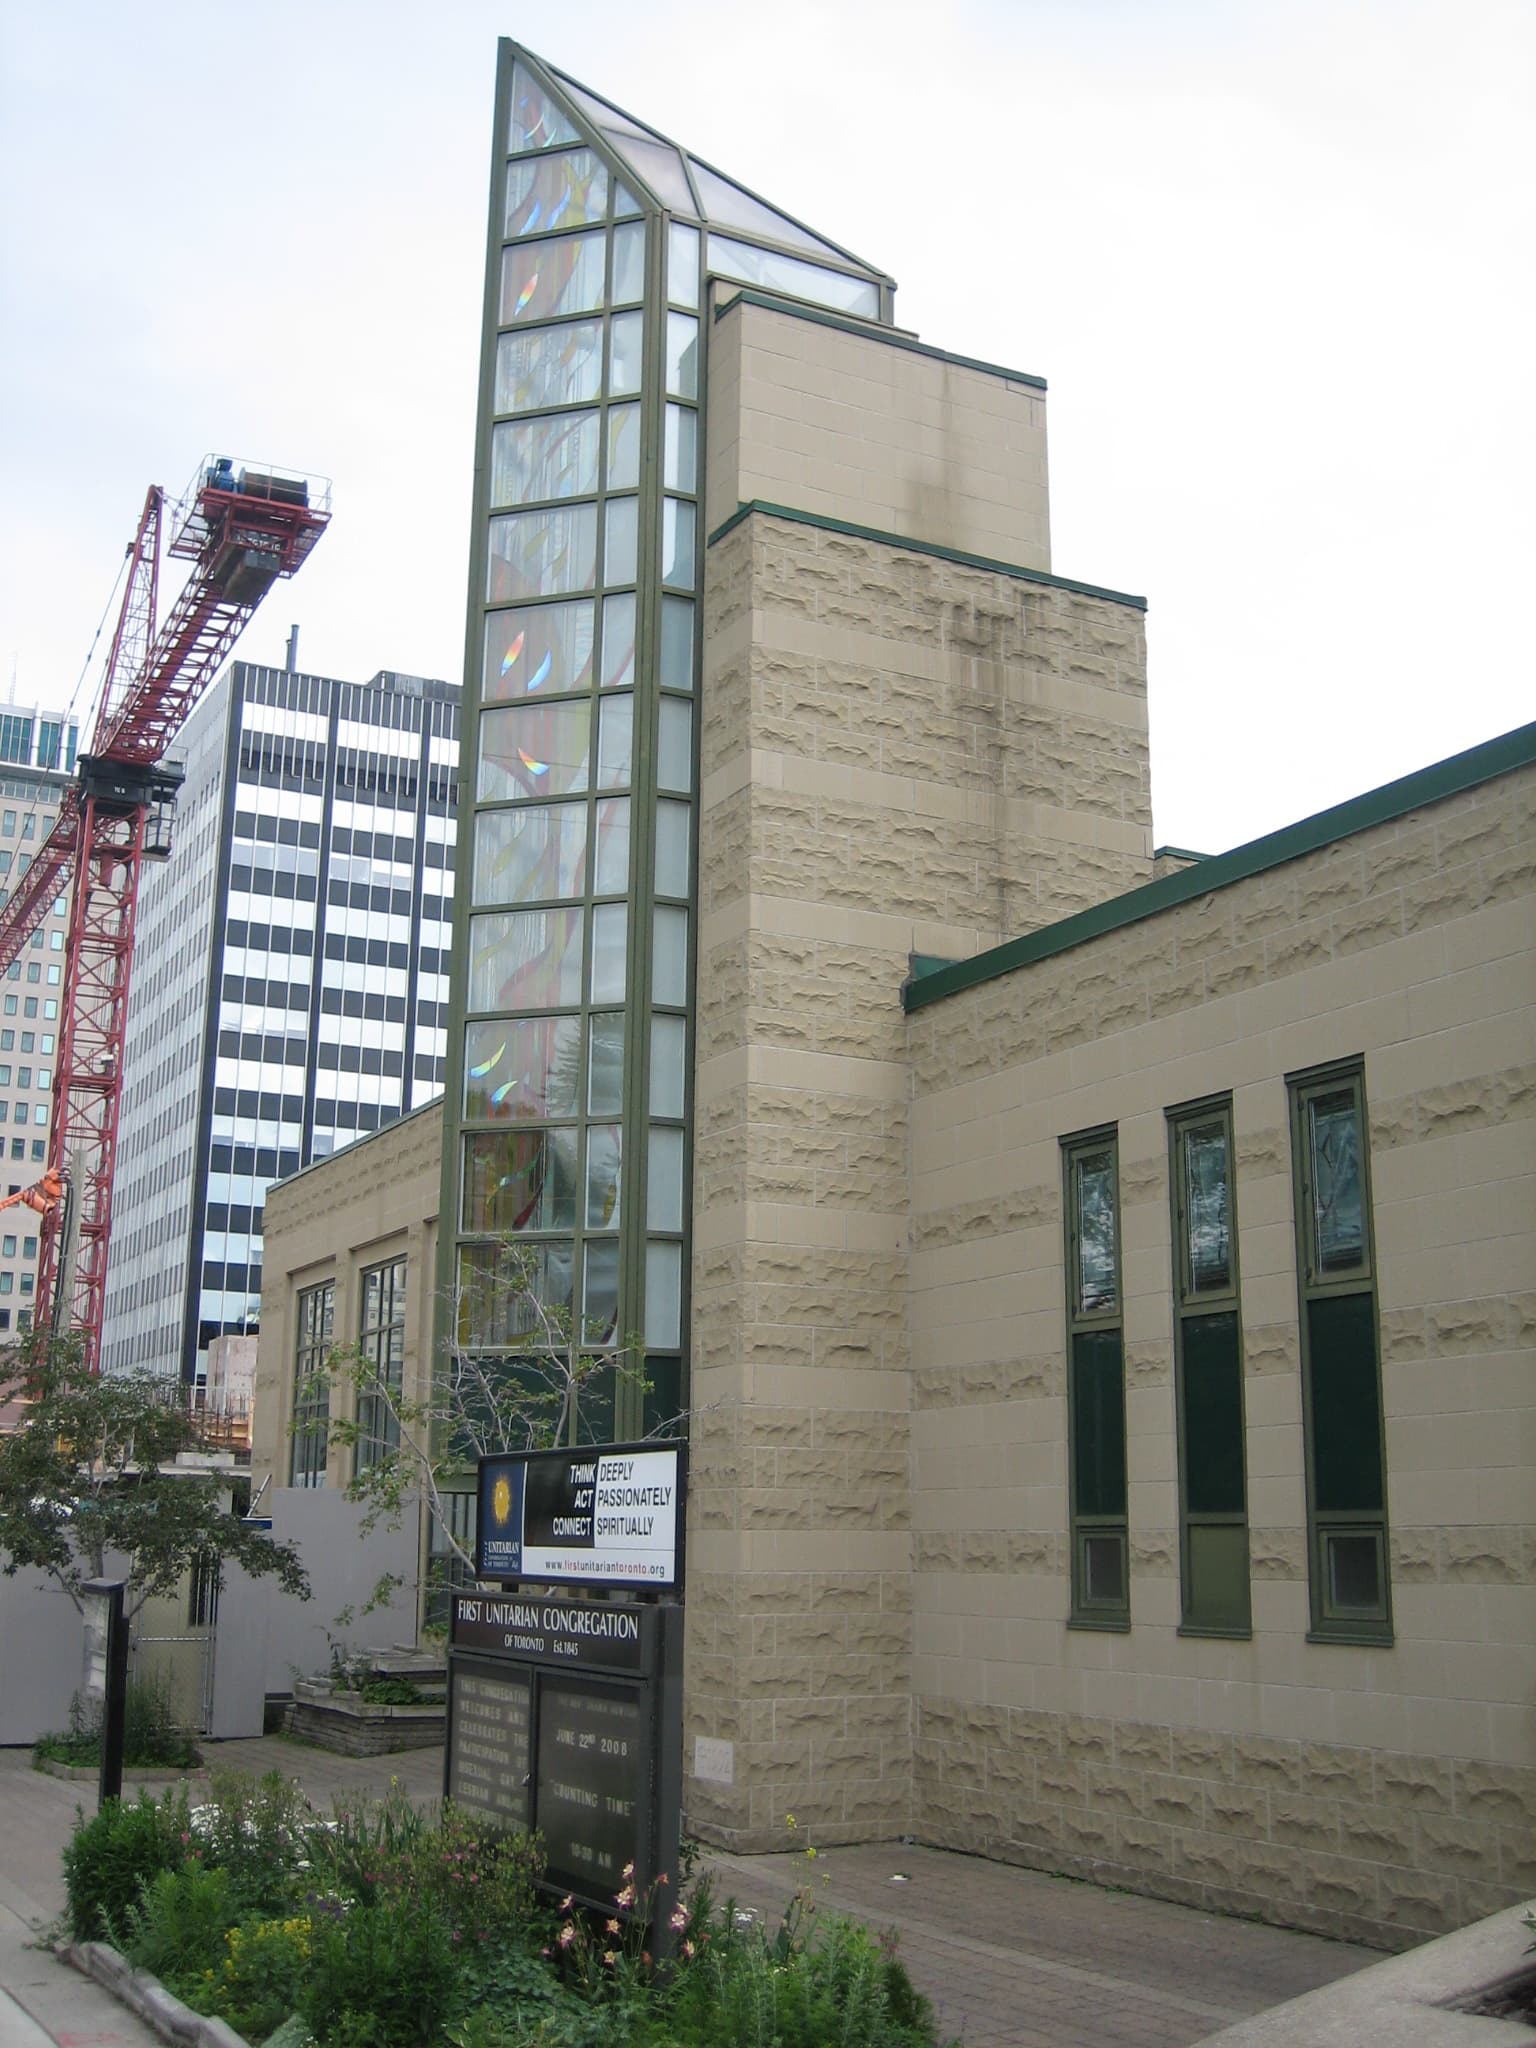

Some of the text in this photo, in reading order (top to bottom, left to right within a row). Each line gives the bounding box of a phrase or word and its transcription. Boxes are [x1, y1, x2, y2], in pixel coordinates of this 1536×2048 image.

[570, 1461, 634, 1484] THINK DEEPLY
[574, 1487, 672, 1509] ACT PASSIONATELY
[552, 1516, 655, 1537] CONNECT SPIRITUALLY
[488, 1541, 519, 1554] UNITARIAN
[545, 1559, 665, 1578] www.firstunitariantoronto.org
[458, 1599, 638, 1640] FIRST UNITARIAN CONGREGATION
[504, 1633, 514, 1648] OF
[514, 1635, 545, 1652] TORONTO
[556, 1727, 576, 1746] JUNE
[601, 1737, 628, 1757] 2008
